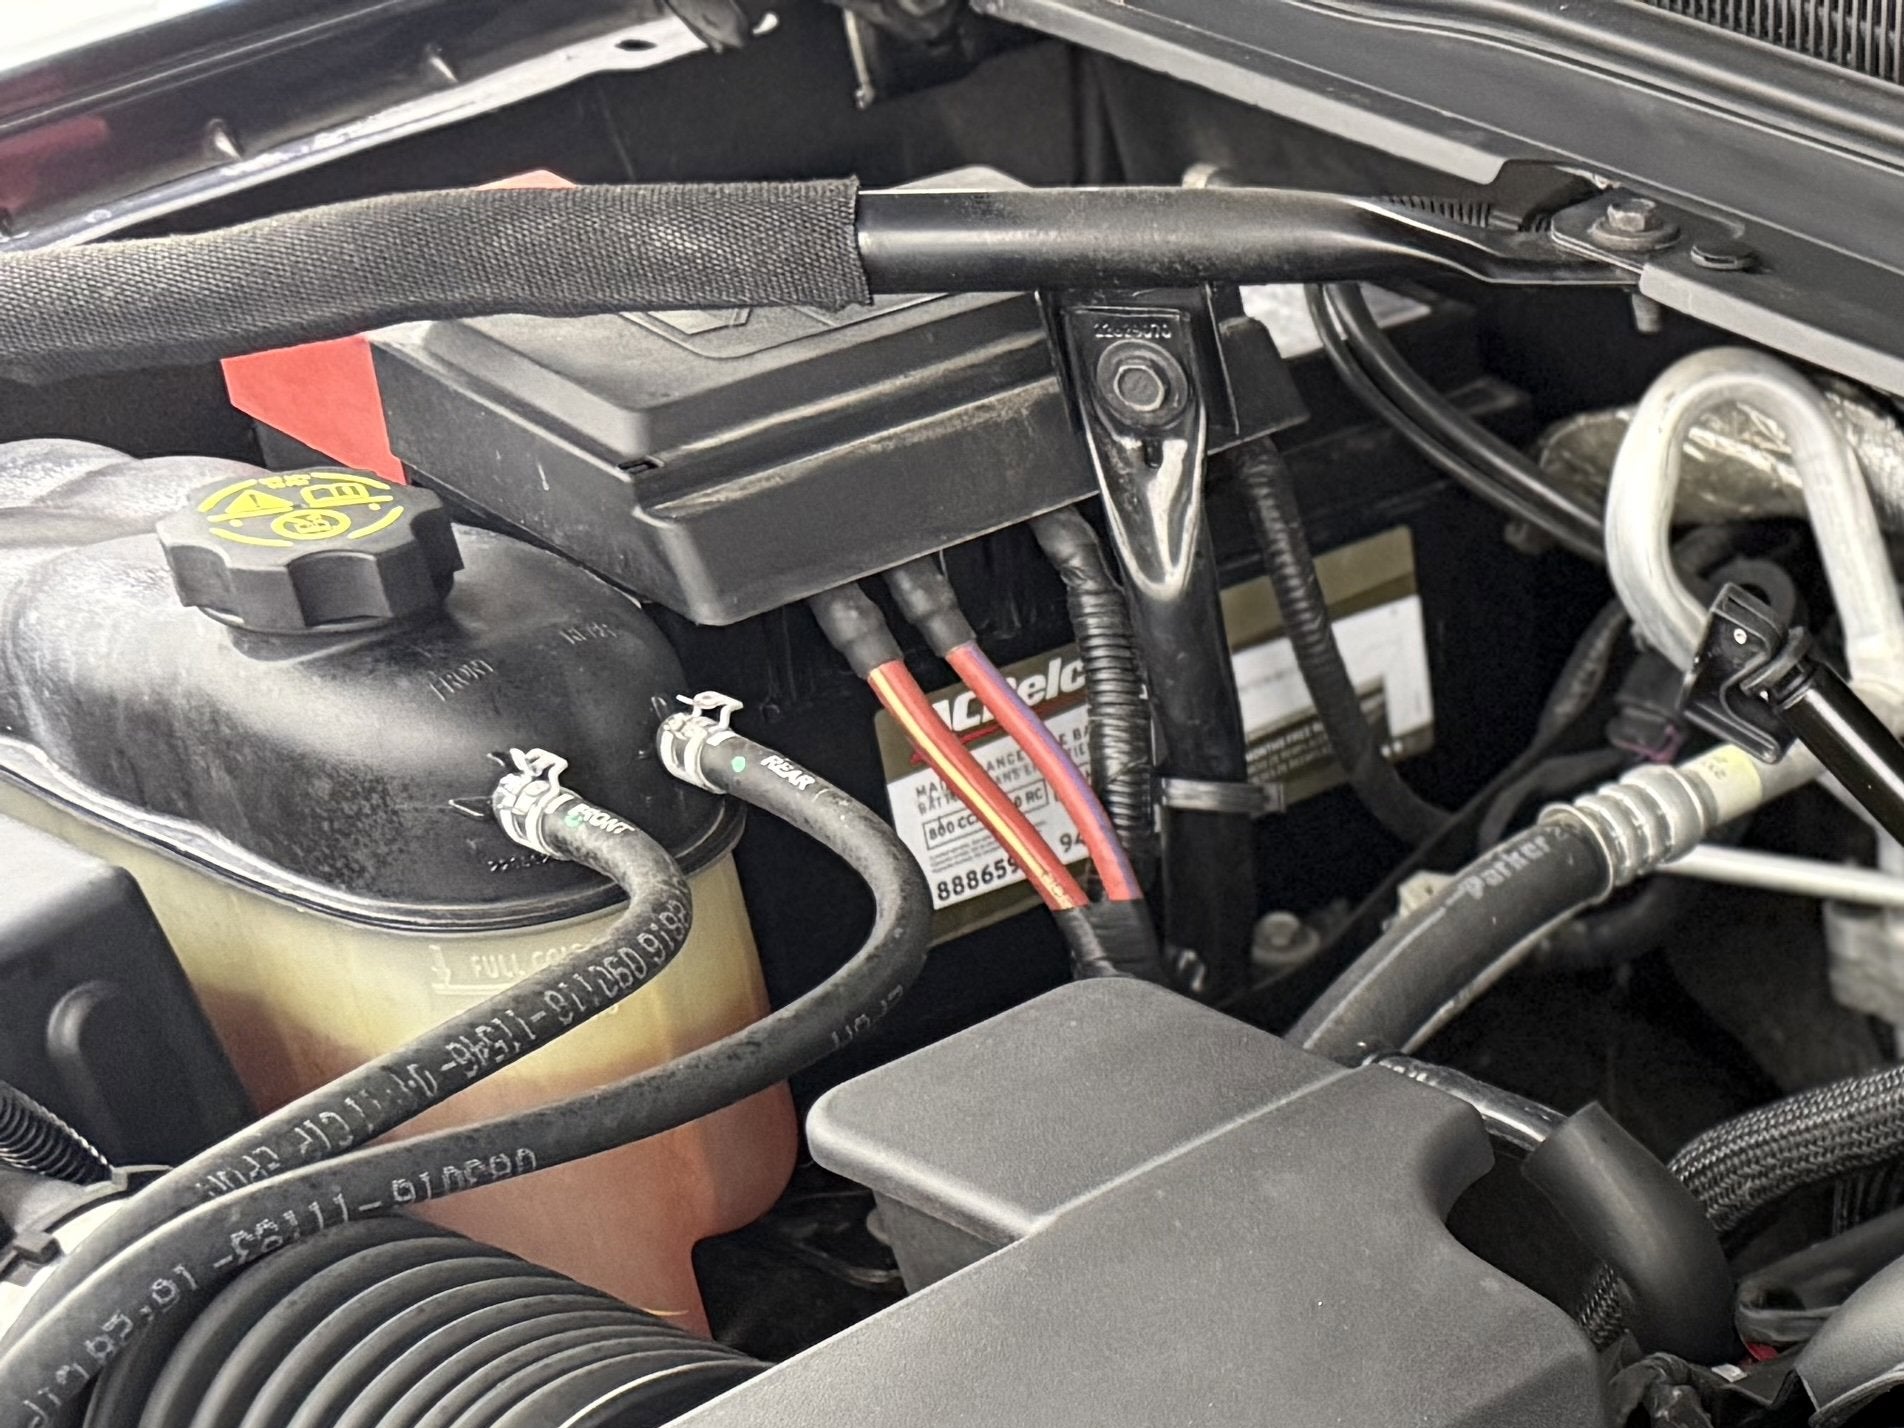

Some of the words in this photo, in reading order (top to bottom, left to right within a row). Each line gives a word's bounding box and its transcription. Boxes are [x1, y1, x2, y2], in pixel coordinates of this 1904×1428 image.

[760, 754, 815, 790] REAR
[1025, 788, 1043, 804] RC
[567, 802, 635, 834] FRONT
[936, 856, 1022, 901] 888659
[1460, 835, 1551, 900] Parker
[471, 952, 524, 978] FULL
